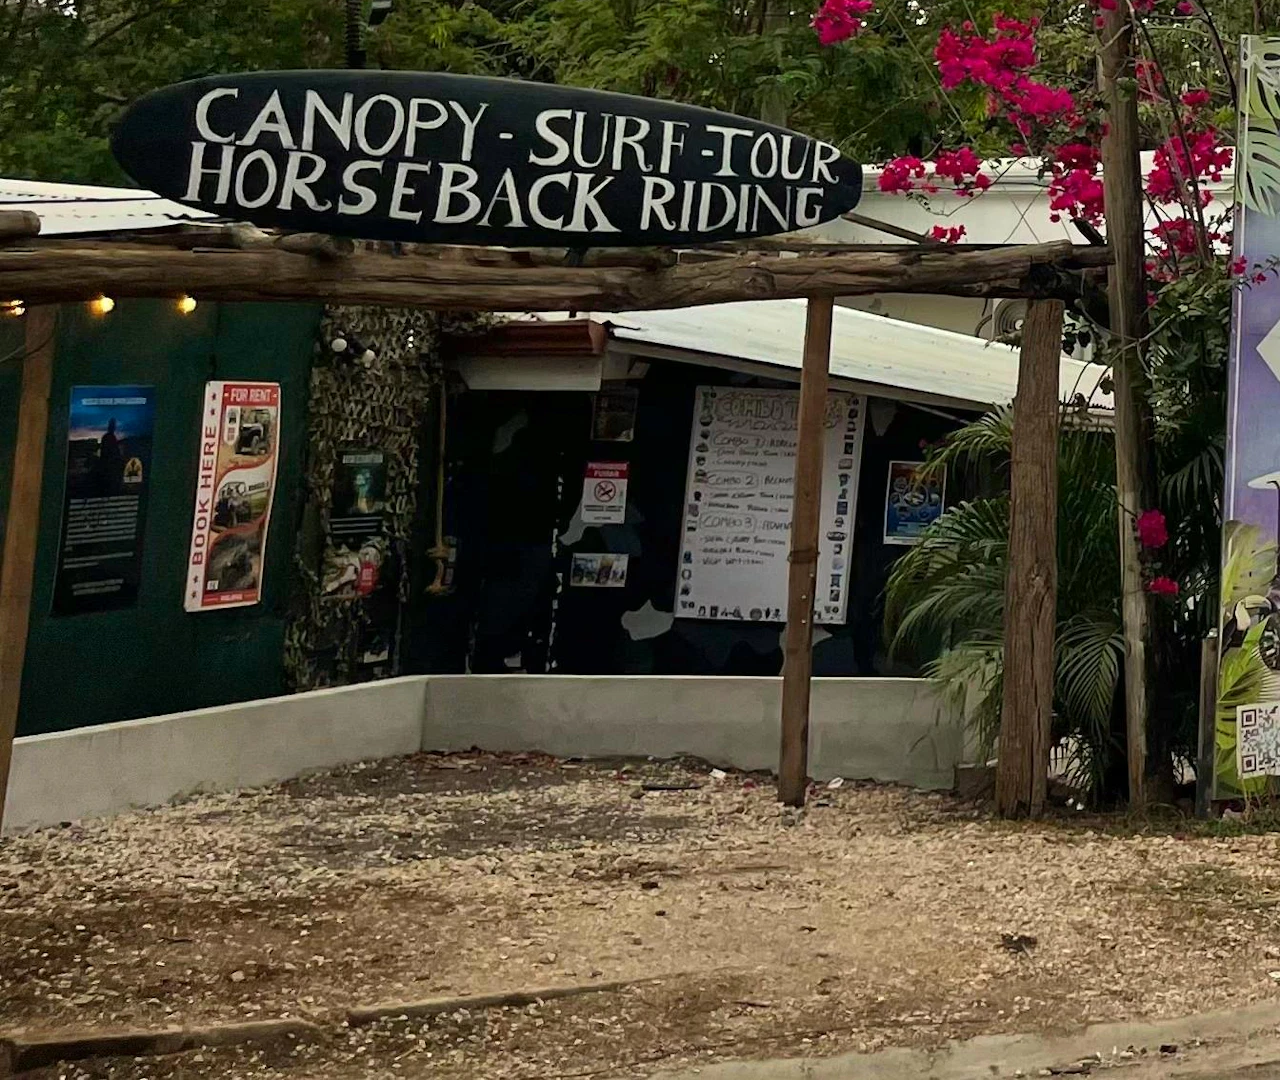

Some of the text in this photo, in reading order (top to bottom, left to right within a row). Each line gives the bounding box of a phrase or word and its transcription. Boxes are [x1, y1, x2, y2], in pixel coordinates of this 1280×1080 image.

[195, 87, 490, 161] CANOPY
[528, 108, 690, 174] SURF
[180, 140, 825, 234] HORSEBACK RIDING
[230, 388, 271, 402] FOR RENT
[192, 426, 217, 566] BOOK HERE
